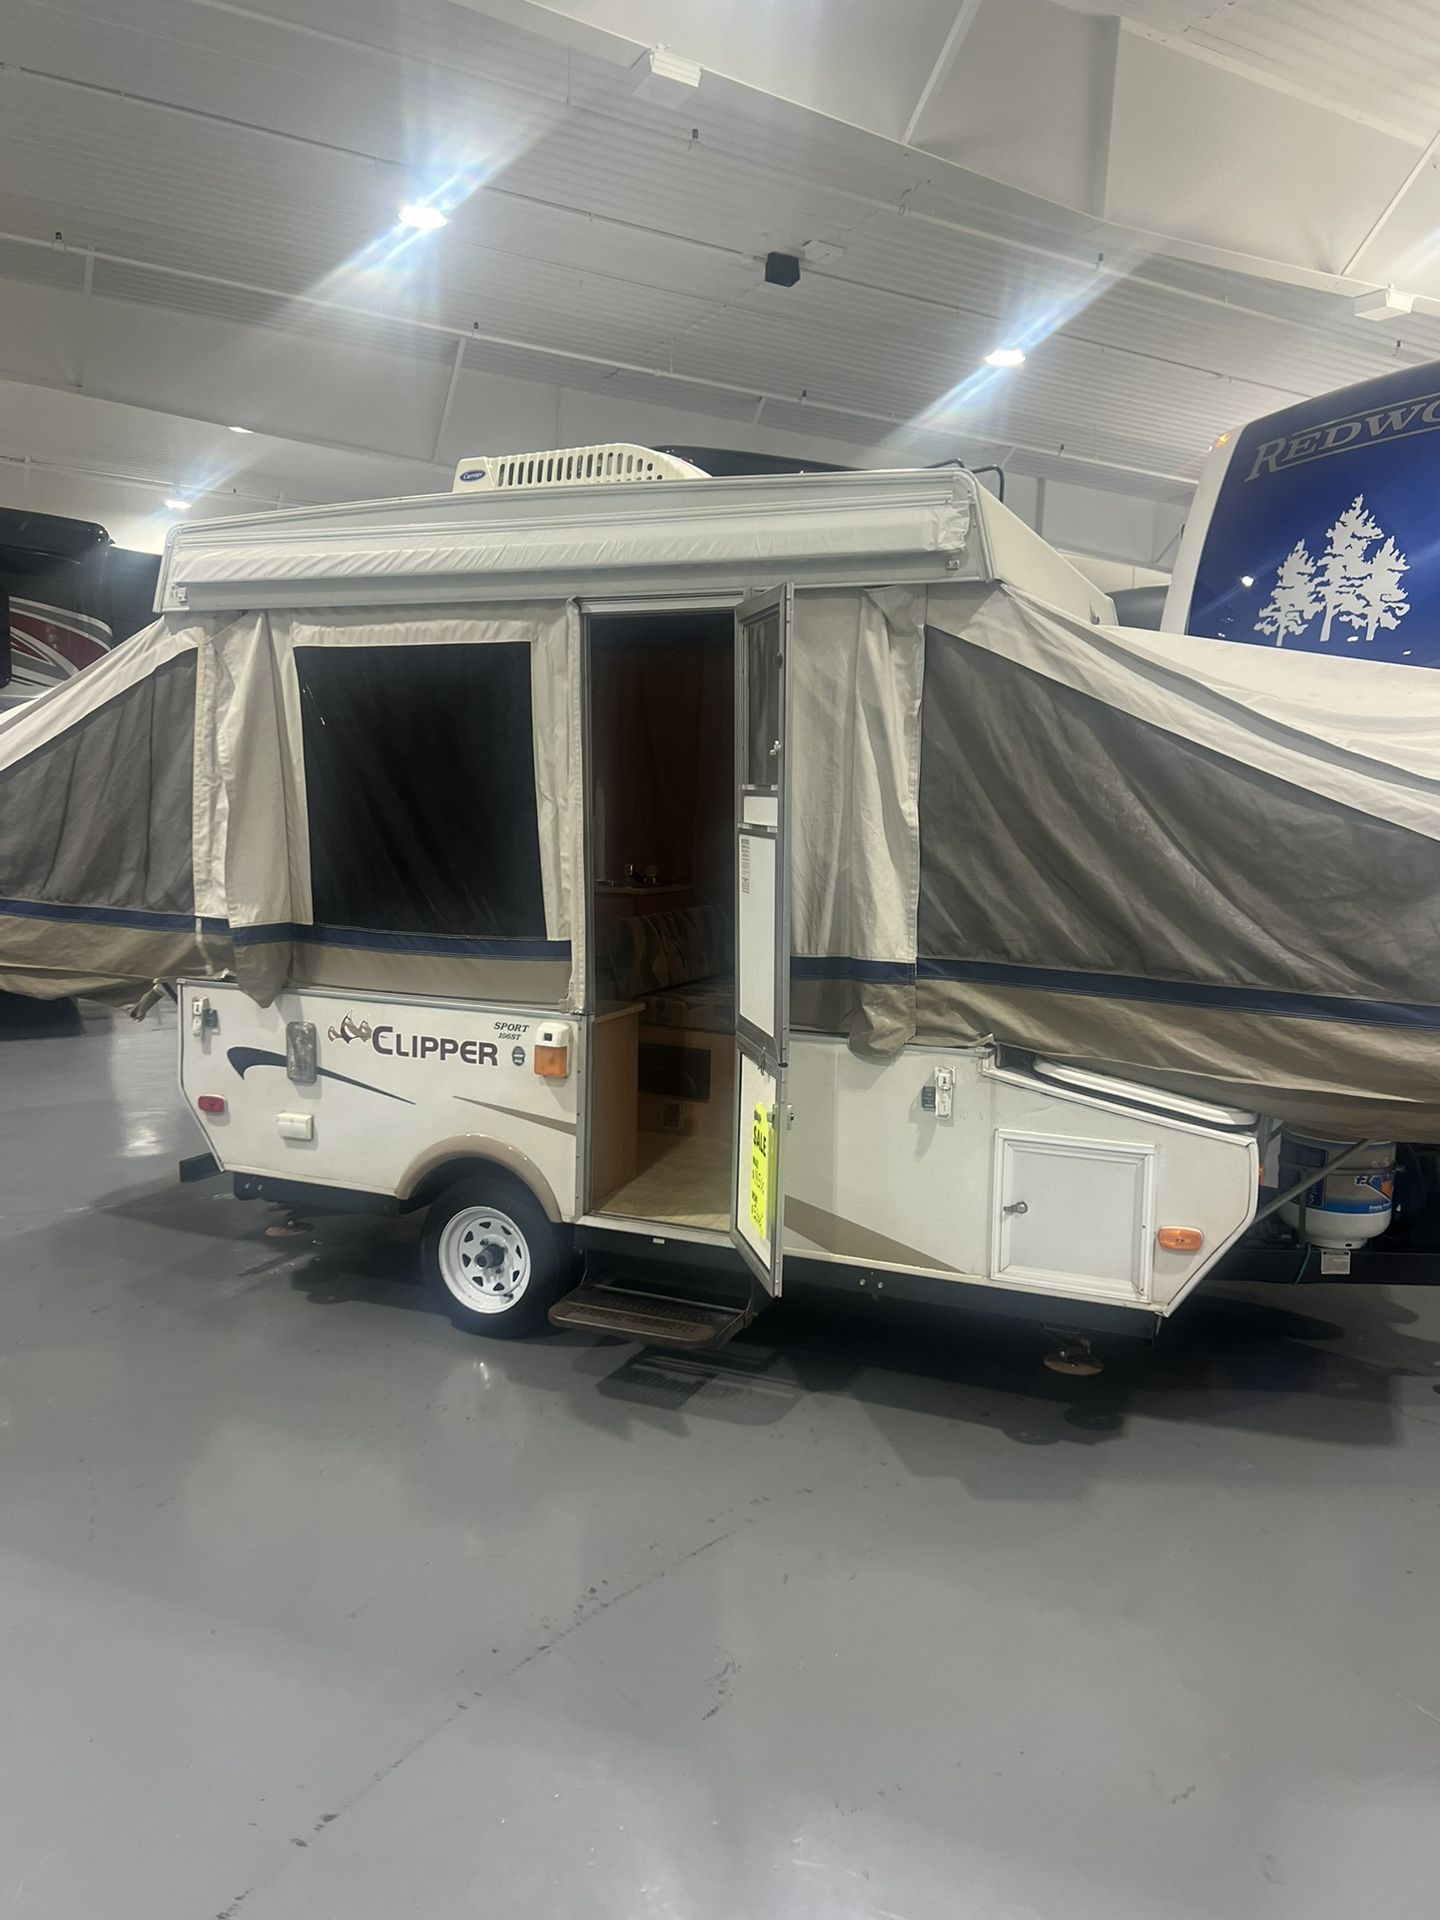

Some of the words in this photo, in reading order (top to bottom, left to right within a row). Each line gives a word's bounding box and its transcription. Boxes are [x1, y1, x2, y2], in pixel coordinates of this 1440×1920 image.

[493, 1021, 530, 1033] SPORT
[371, 1025, 499, 1067] CLIPPER
[753, 1125, 767, 1158] SALE
